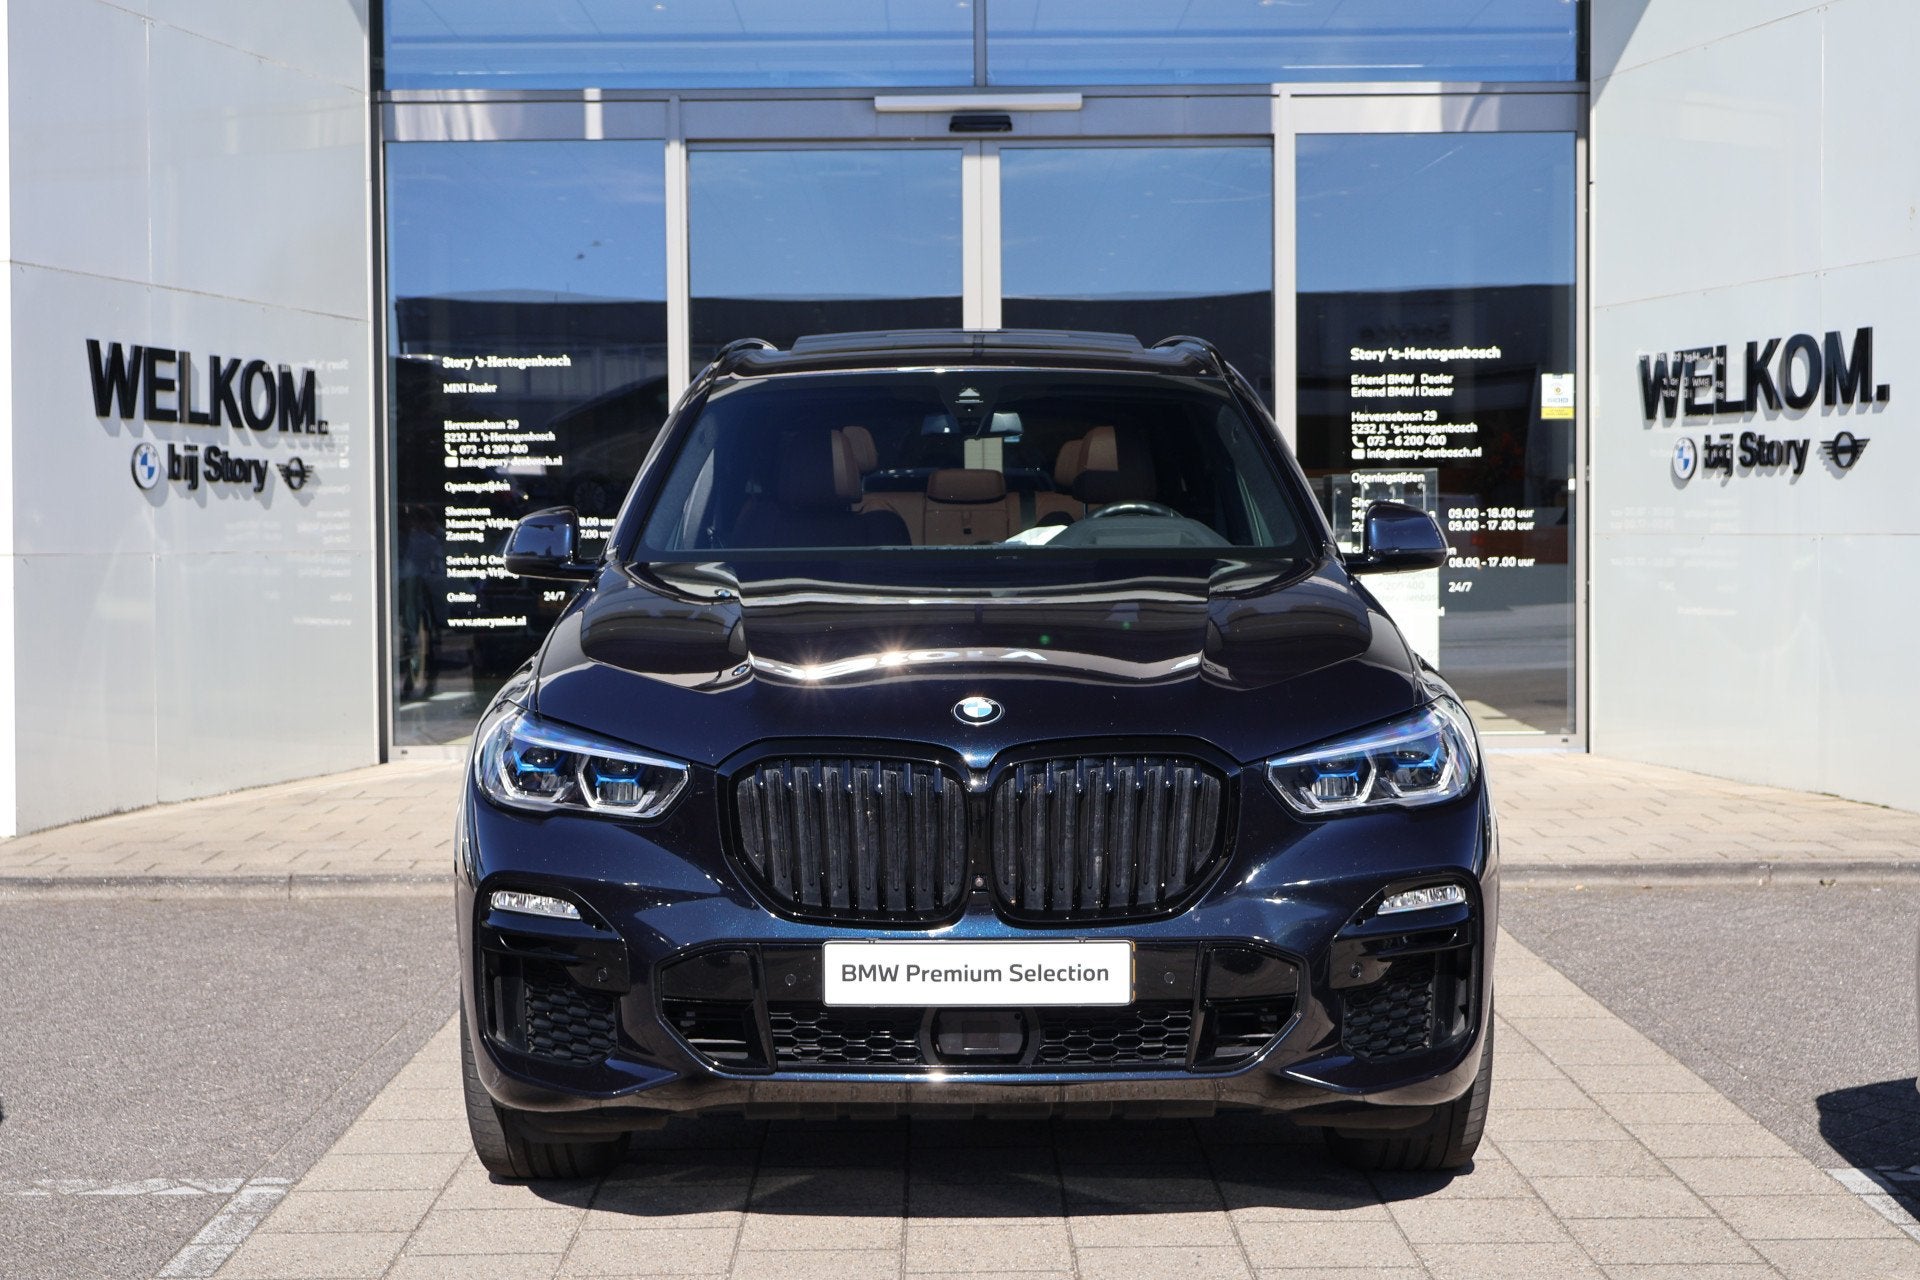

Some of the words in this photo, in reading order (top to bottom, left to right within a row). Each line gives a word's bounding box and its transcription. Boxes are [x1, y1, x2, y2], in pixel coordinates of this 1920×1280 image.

[1350, 348, 1386, 362] Story
[443, 356, 473, 370] Story
[1351, 374, 1385, 385] Erkend
[1388, 374, 1414, 385] BMW
[1421, 373, 1454, 384] Dealer
[1640, 327, 1890, 420] WELKOM.
[86, 339, 328, 435] WELKOM.
[1351, 387, 1385, 397] Erkend
[1388, 386, 1414, 397] BMW
[1421, 386, 1454, 397] Dealer
[1423, 410, 1437, 421] 29
[507, 420, 519, 430] 29
[1351, 424, 1376, 434] 5232
[1367, 436, 1386, 446] 073
[1394, 436, 1402, 446] 6
[1403, 436, 1424, 446] 200
[1426, 435, 1447, 446] 400
[1739, 431, 1810, 475] Story
[204, 445, 268, 492] Story
[1351, 472, 1425, 485] Openingstijden
[1448, 508, 1479, 519] 09.00
[1487, 508, 1515, 518] 18.00
[1517, 509, 1534, 518] uur
[1448, 520, 1479, 531] 09.00
[1517, 522, 1534, 530] uur
[1448, 557, 1479, 568] 08.00
[1517, 558, 1535, 567] uur
[1448, 582, 1472, 592] 24/7
[543, 592, 565, 601] 24/7
[842, 964, 899, 982] BMW
[906, 964, 1002, 982] Premium
[1009, 963, 1109, 982] Selection
